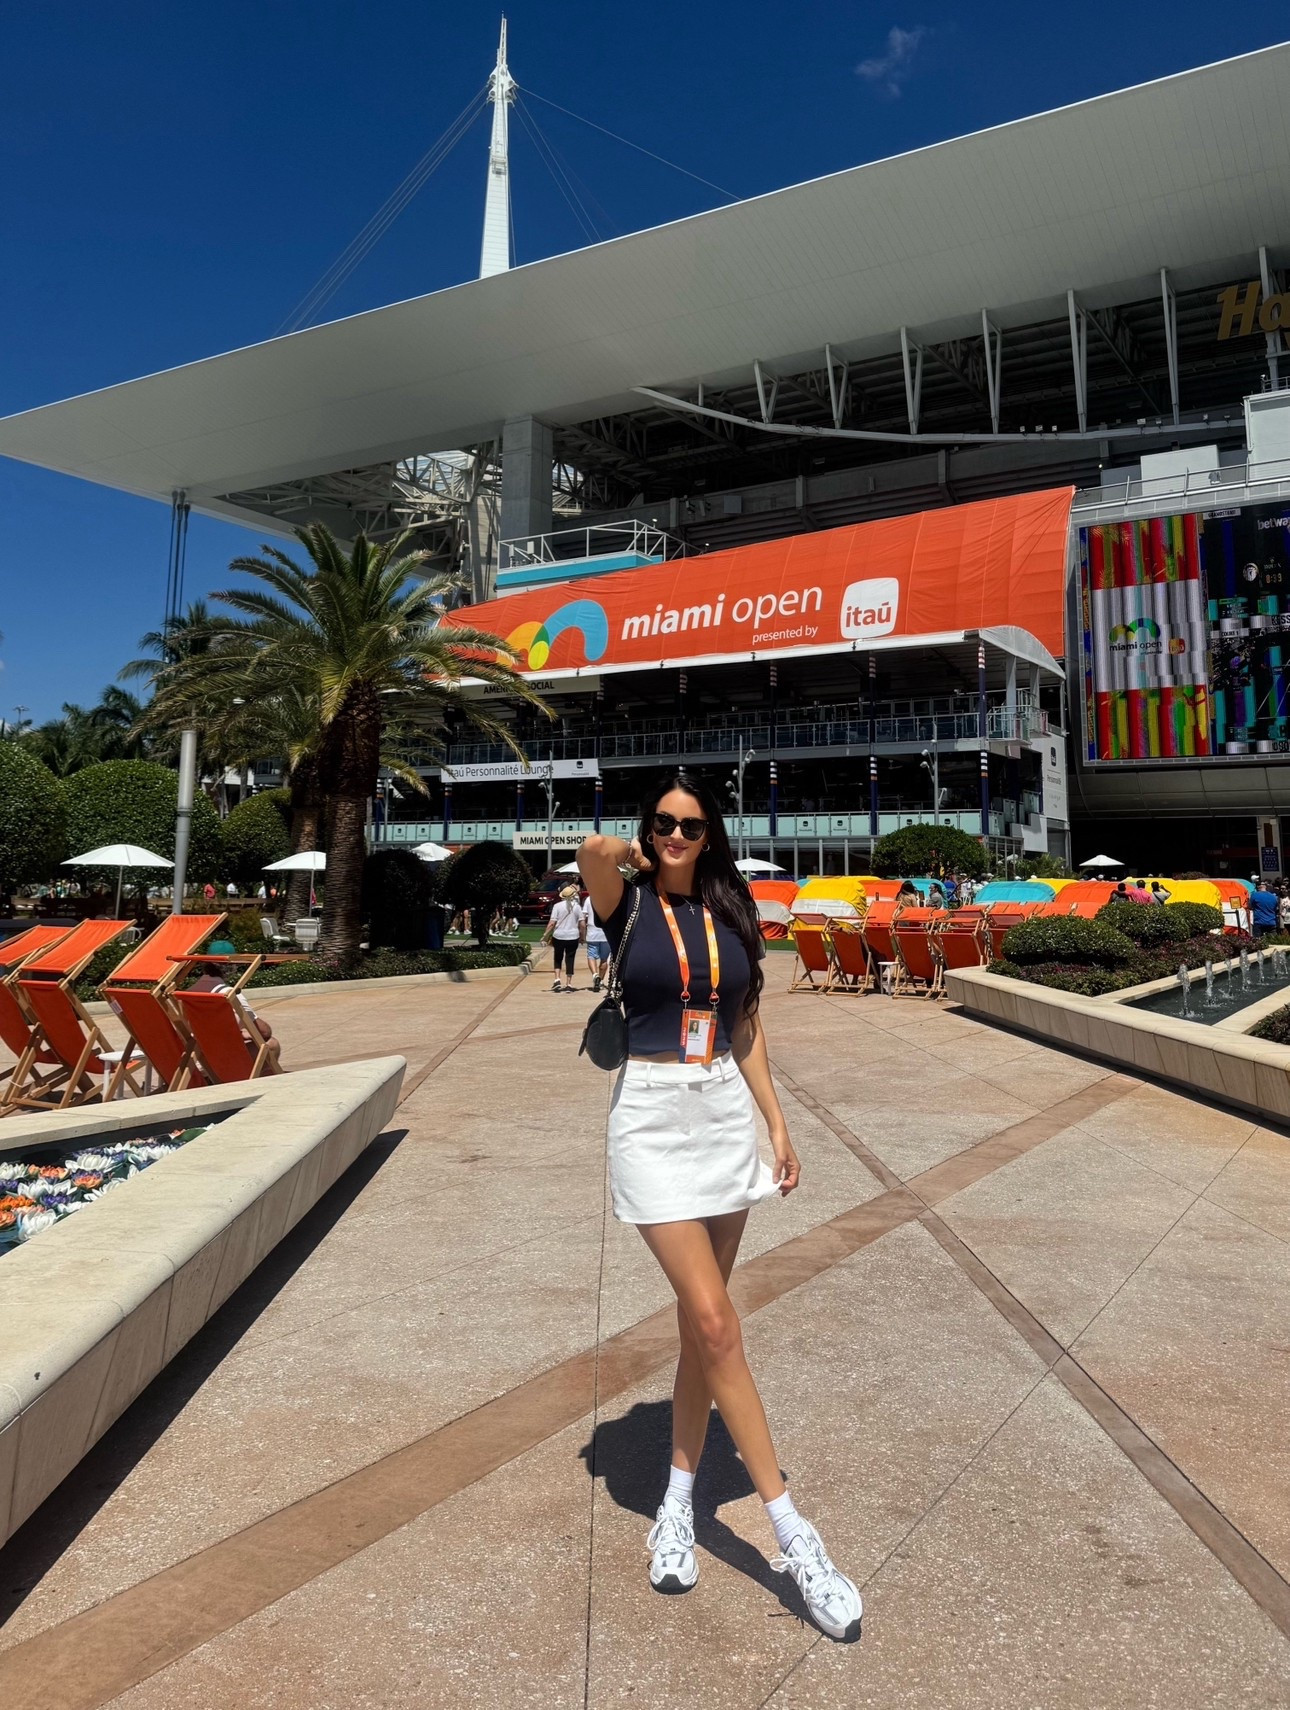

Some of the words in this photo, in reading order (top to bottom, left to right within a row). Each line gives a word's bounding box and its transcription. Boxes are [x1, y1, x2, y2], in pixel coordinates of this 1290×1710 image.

[621, 593, 726, 640] miami
[731, 586, 823, 629] open
[845, 601, 892, 628] itaú
[752, 626, 803, 645] presented
[804, 625, 818, 638] by
[1110, 642, 1137, 652] miami
[1140, 641, 1162, 653] open
[465, 764, 519, 778] Personnalité
[520, 836, 543, 845] MIAMI
